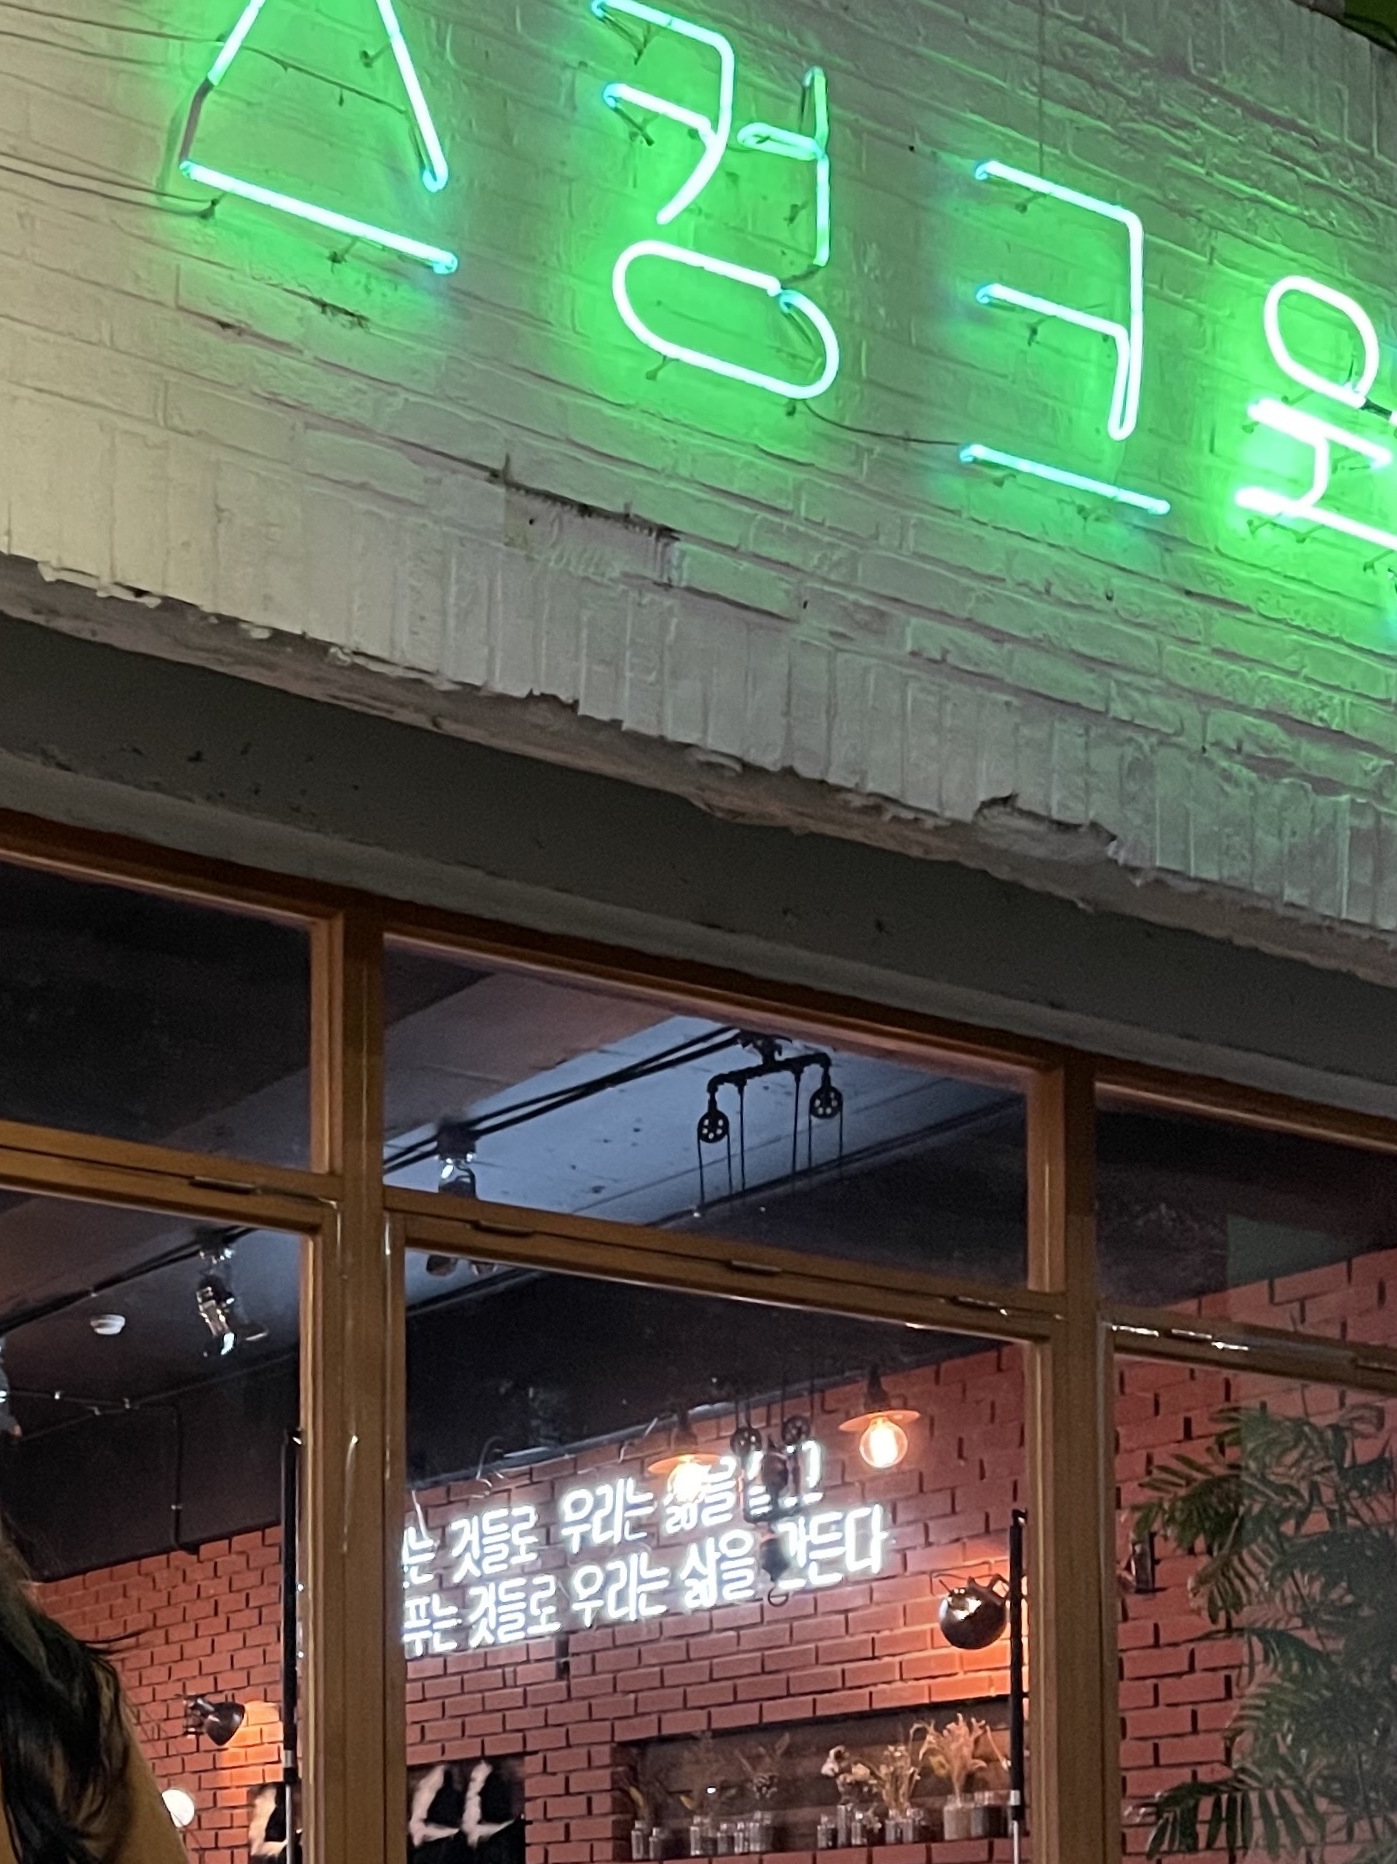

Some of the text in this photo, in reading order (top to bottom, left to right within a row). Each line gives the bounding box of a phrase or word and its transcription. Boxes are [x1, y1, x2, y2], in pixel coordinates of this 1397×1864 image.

[402, 1526, 436, 1589] 는
[450, 1505, 539, 1583] 것들로
[561, 1476, 656, 1554] 우리는
[468, 1574, 561, 1648] 것들로
[572, 1552, 670, 1628] 우리는
[680, 1529, 755, 1609] 삶을
